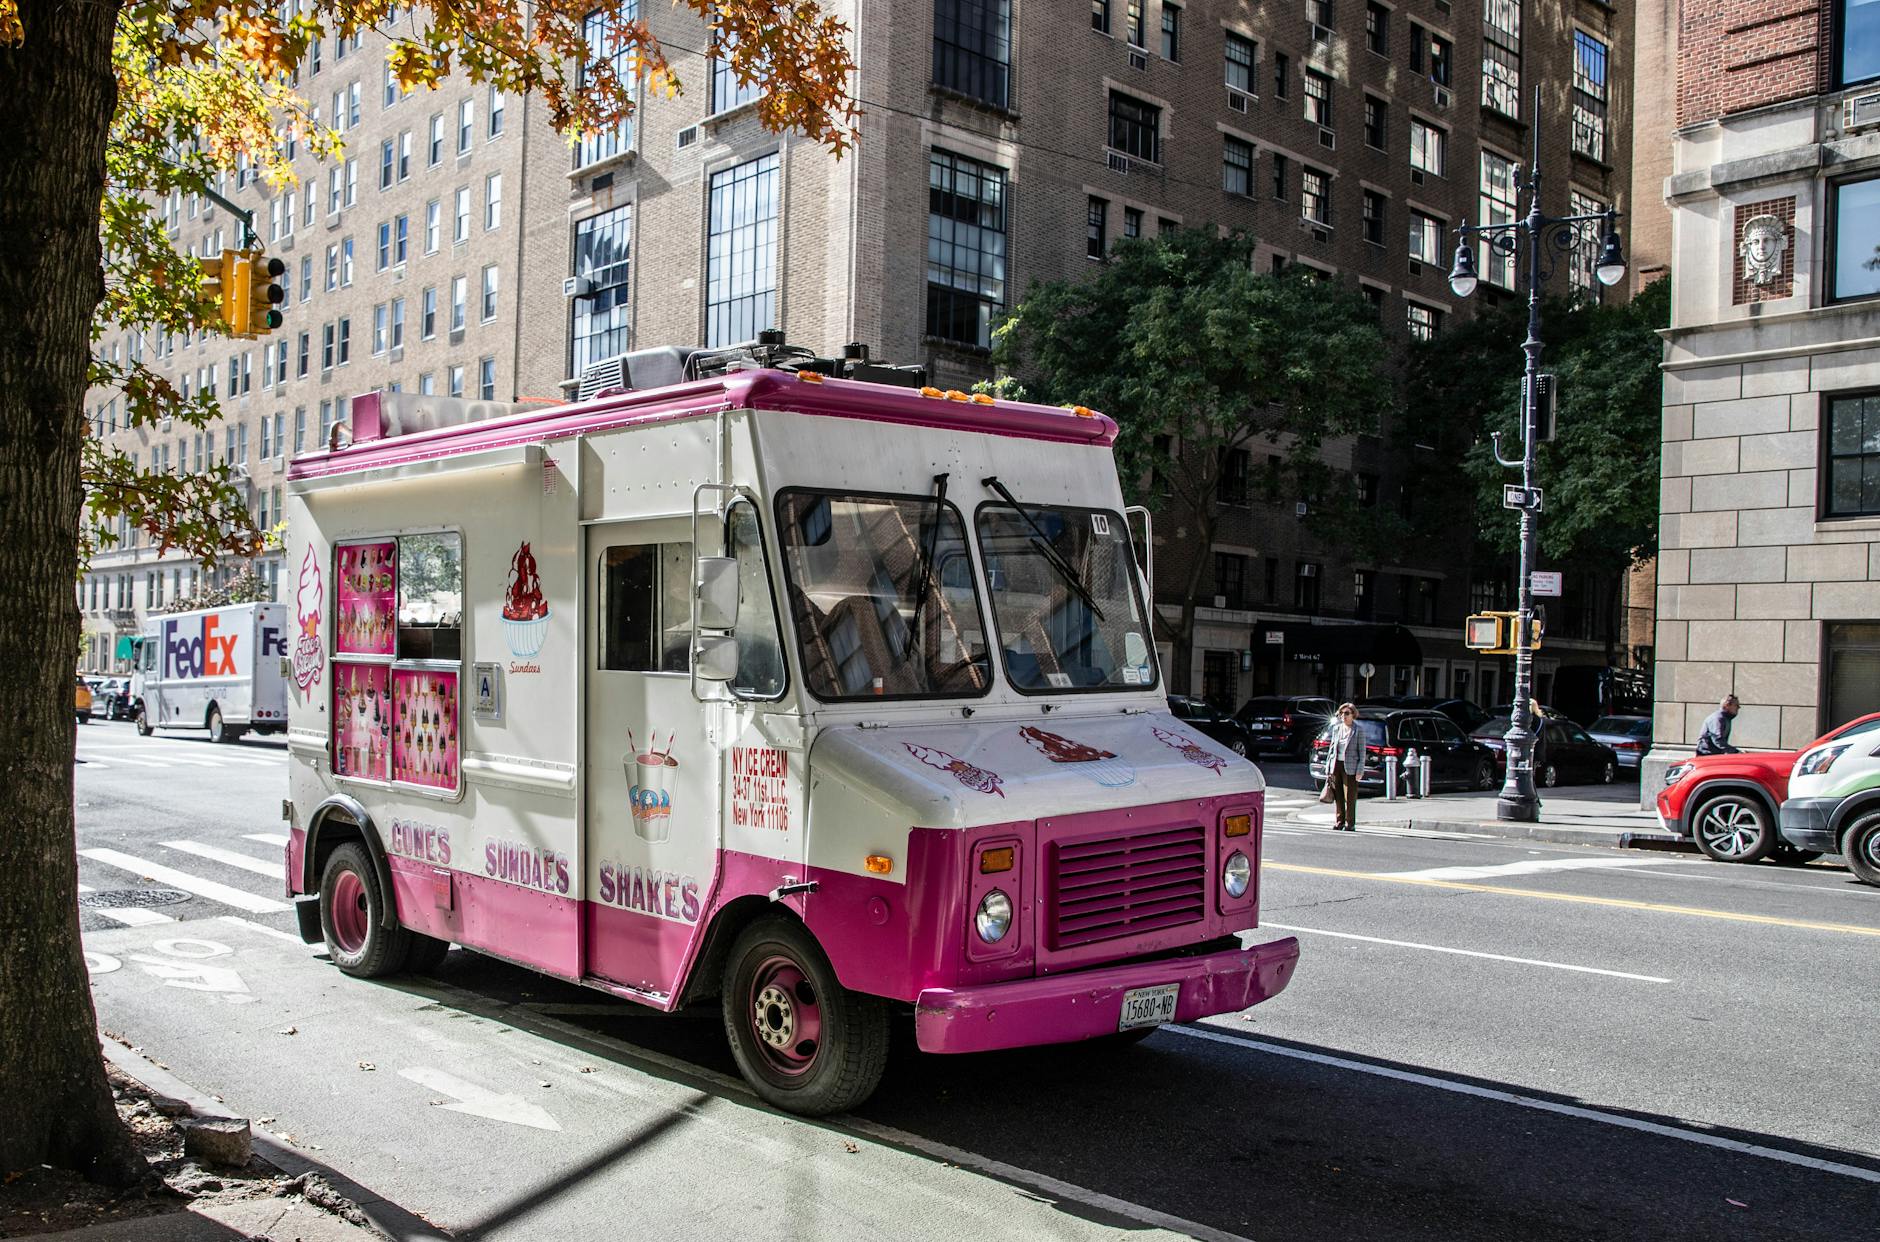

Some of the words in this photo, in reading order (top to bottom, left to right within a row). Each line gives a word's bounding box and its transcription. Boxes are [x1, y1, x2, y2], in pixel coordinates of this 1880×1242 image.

[1511, 492, 1523, 502] ONE
[1094, 516, 1107, 533] 10
[165, 615, 238, 679] FedEx
[509, 661, 541, 674] Sundaes
[480, 676, 490, 697] A
[733, 746, 743, 775] NY
[746, 747, 758, 776] ICE
[760, 747, 788, 779] CREAM
[733, 775, 751, 801] 34-37
[733, 800, 748, 826] New
[750, 802, 765, 828] York
[767, 804, 788, 831] 11106
[391, 817, 451, 865] CONES
[485, 837, 569, 895] SUNDAES
[600, 858, 701, 923] SHAKES
[1137, 990, 1150, 998] NEW
